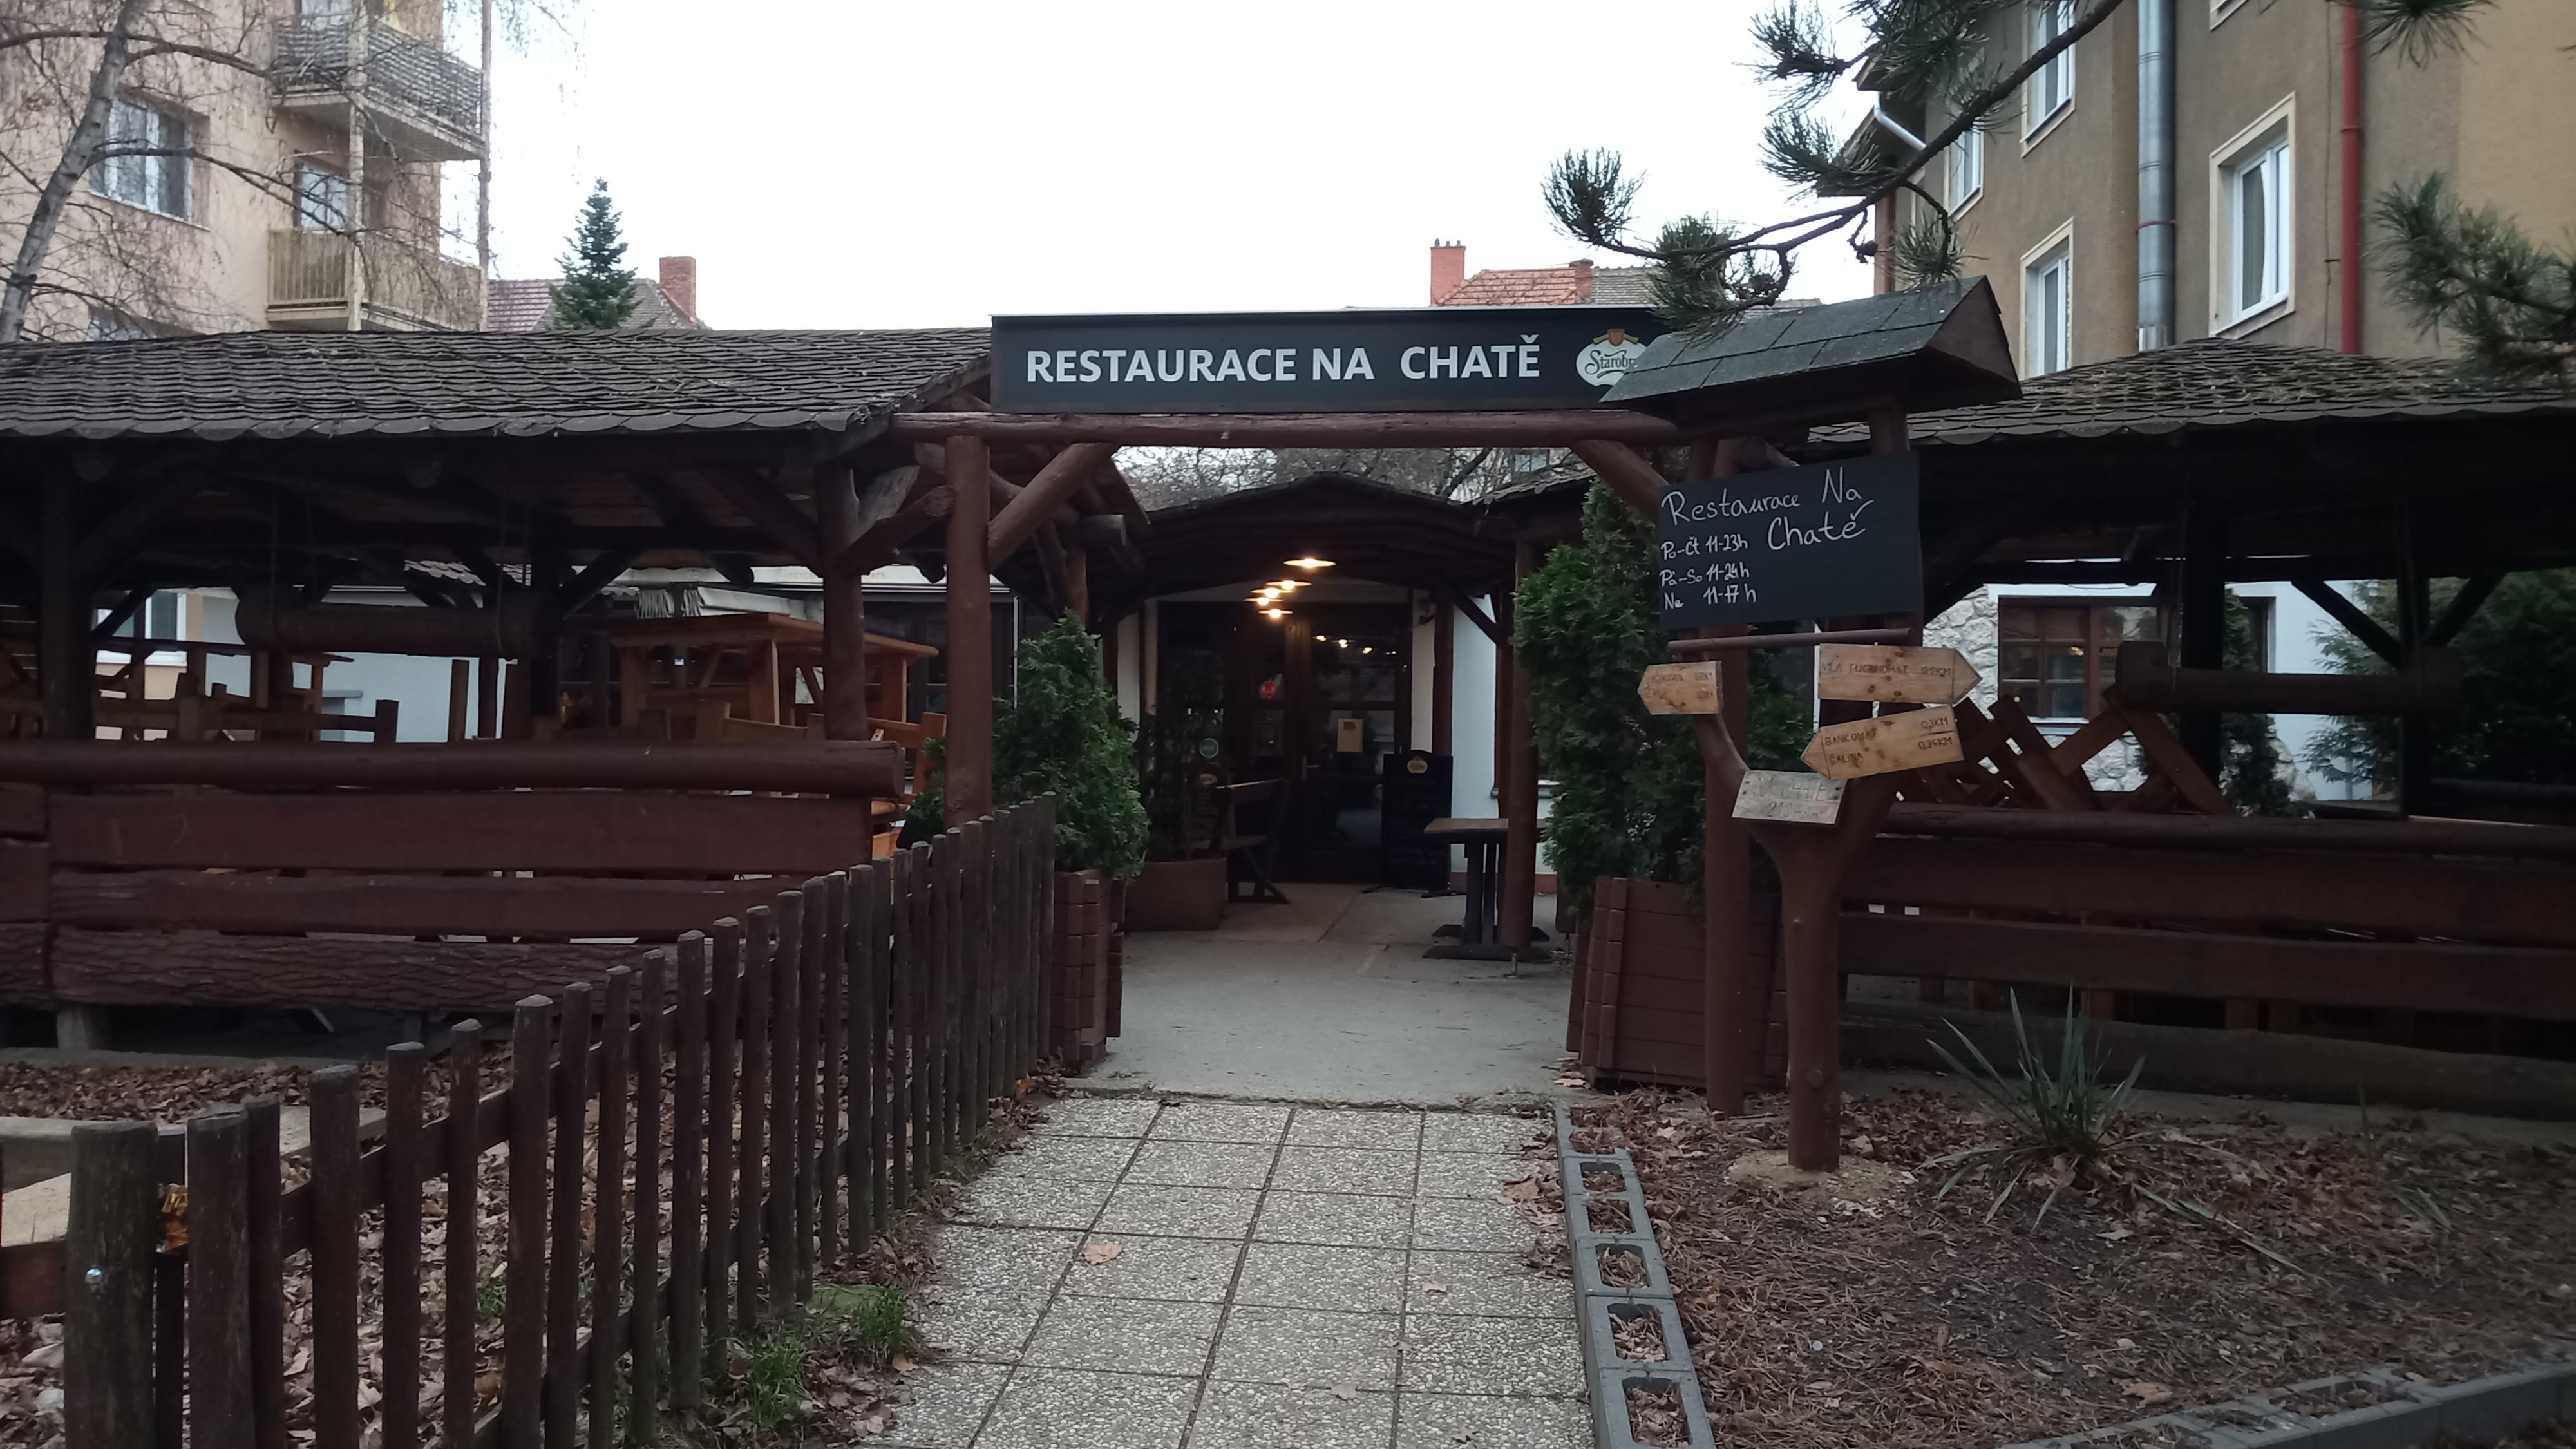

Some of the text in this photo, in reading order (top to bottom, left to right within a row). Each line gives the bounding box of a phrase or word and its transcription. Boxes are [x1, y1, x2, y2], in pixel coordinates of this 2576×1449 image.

[1027, 334, 1540, 383] RESTAURACE NA CHATĚ
[1661, 466, 1862, 526] Restaurace Na
[1767, 500, 1874, 551] Chatě
[1663, 592, 1684, 610] Ne
[1824, 728, 1877, 746] BANKOMAT
